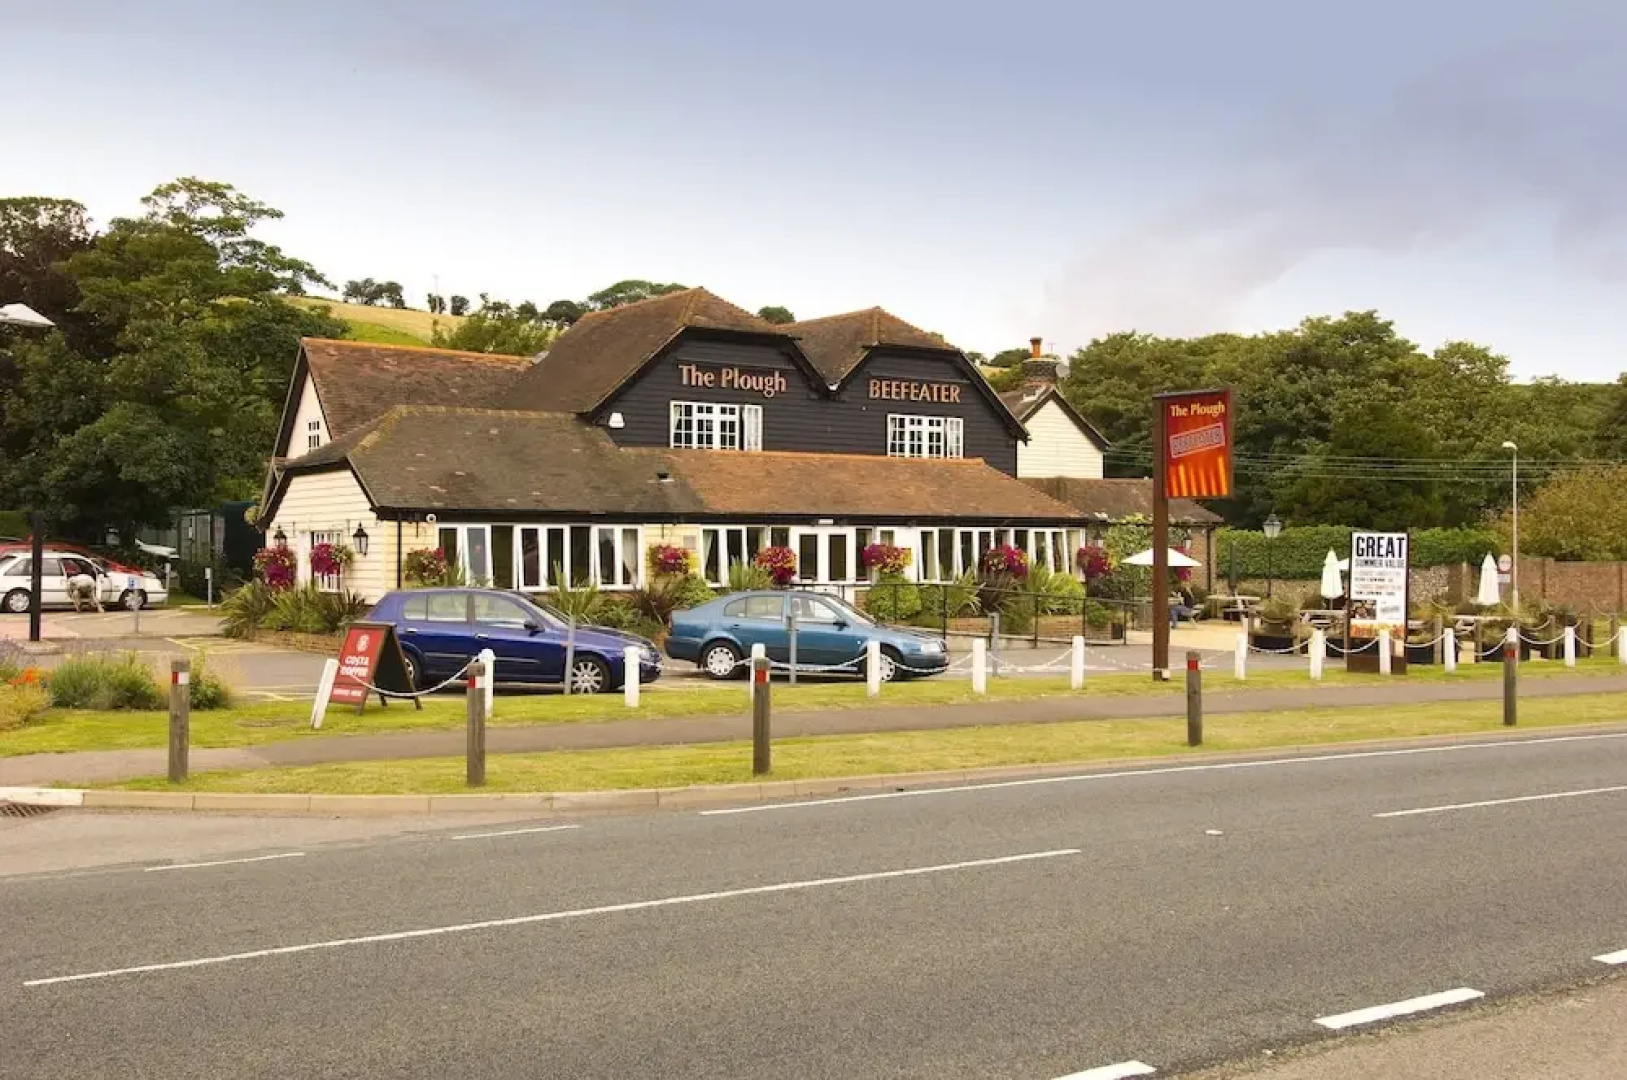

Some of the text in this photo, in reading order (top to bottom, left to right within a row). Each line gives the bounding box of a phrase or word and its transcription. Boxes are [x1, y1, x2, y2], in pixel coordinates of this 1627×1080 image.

[678, 364, 786, 398] The Plough
[869, 379, 961, 403] BEEFEATER
[1170, 402, 1225, 417] The Plough
[1356, 536, 1405, 558] GREAT
[344, 655, 370, 666] COSTA
